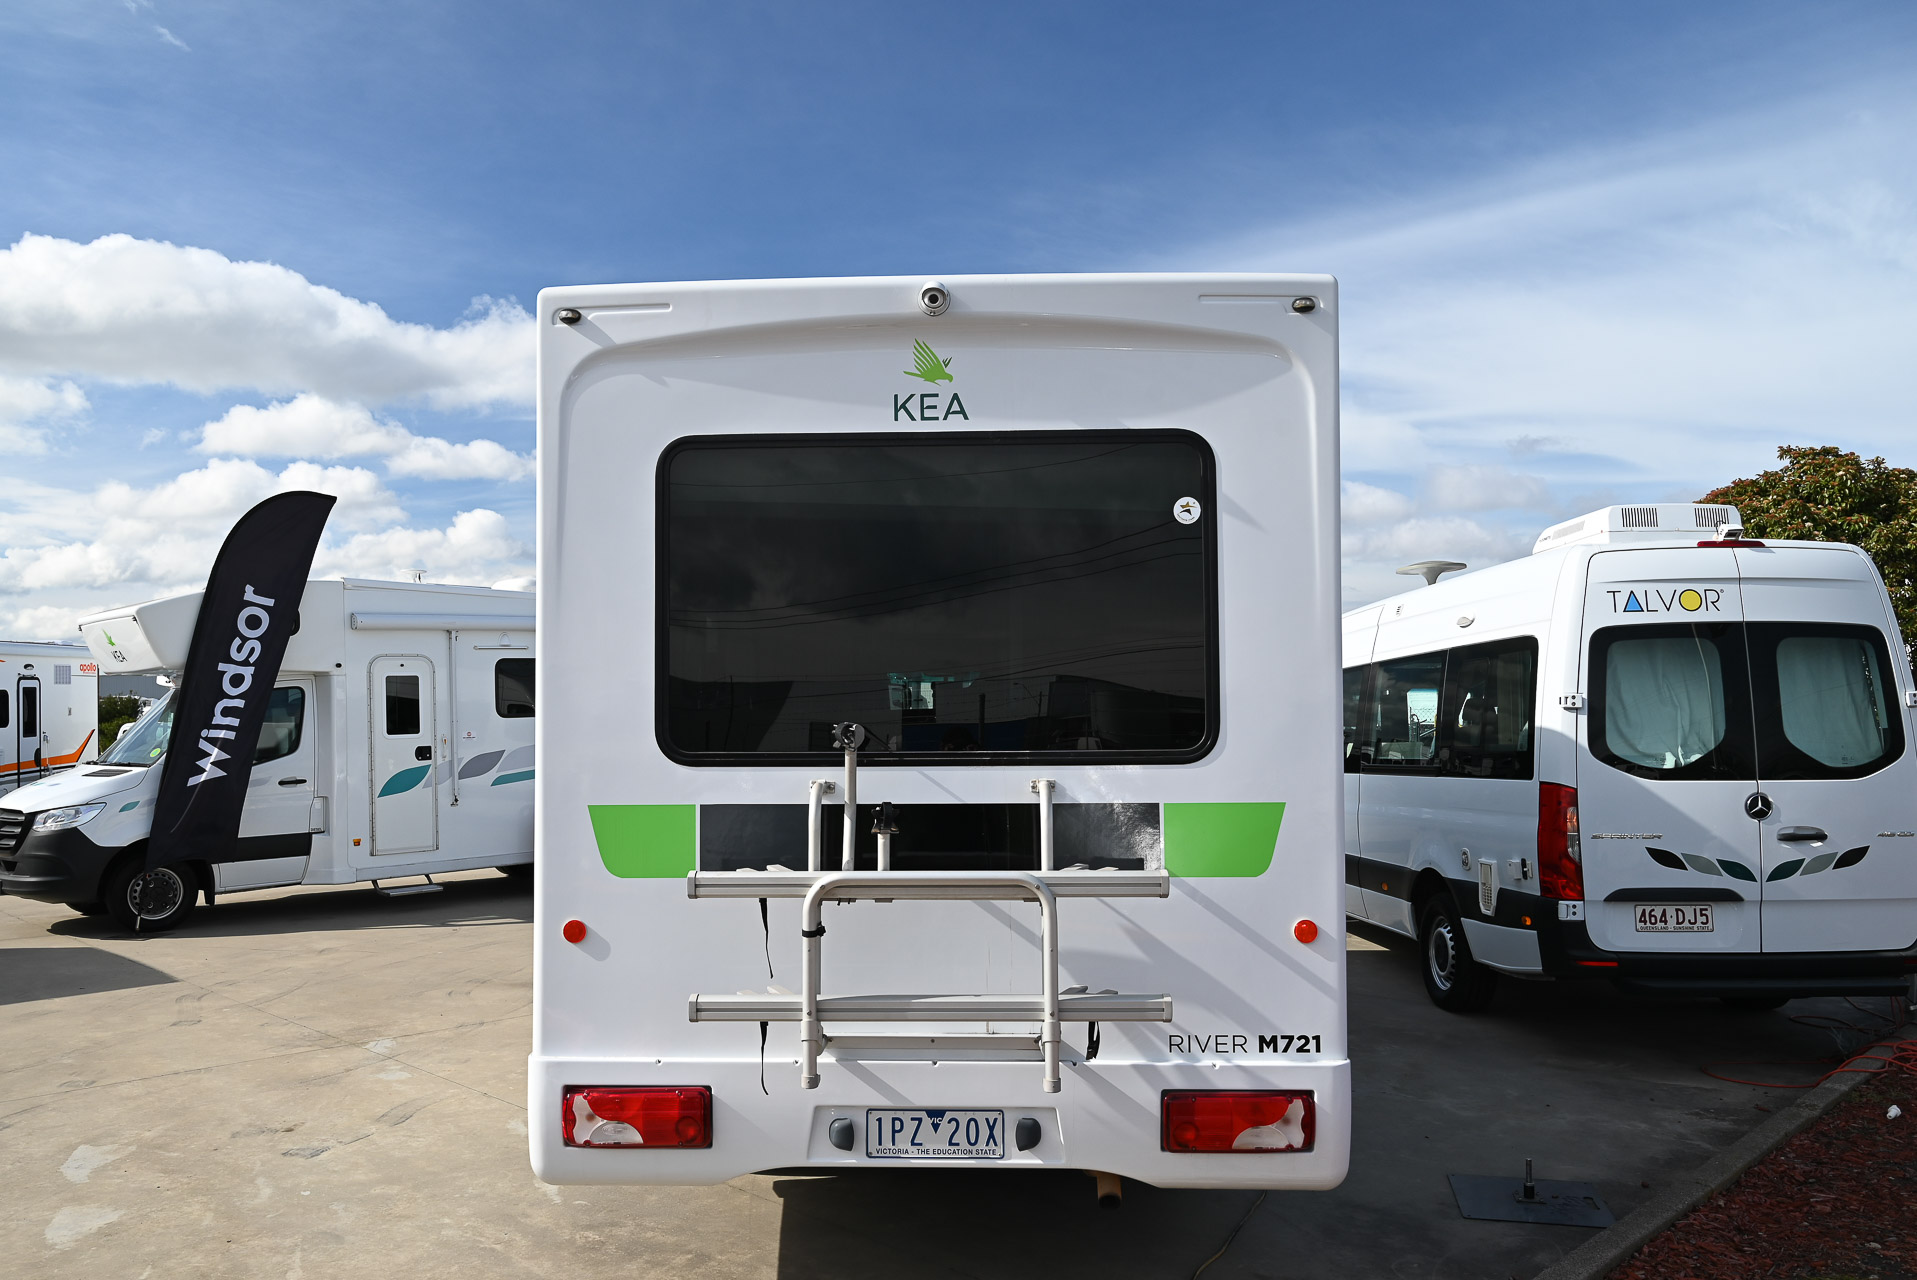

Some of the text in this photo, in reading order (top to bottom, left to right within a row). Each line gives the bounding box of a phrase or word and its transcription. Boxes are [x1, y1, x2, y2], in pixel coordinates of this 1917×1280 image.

[893, 392, 970, 422] KEA
[79, 662, 97, 672] apollo
[1168, 1034, 1322, 1054] RIVER M721
[875, 1116, 999, 1147] 1PZ 20X
[875, 1147, 910, 1155] VICTORIA
[932, 1148, 973, 1156] EDUCATION
[975, 1148, 997, 1156] STATE
